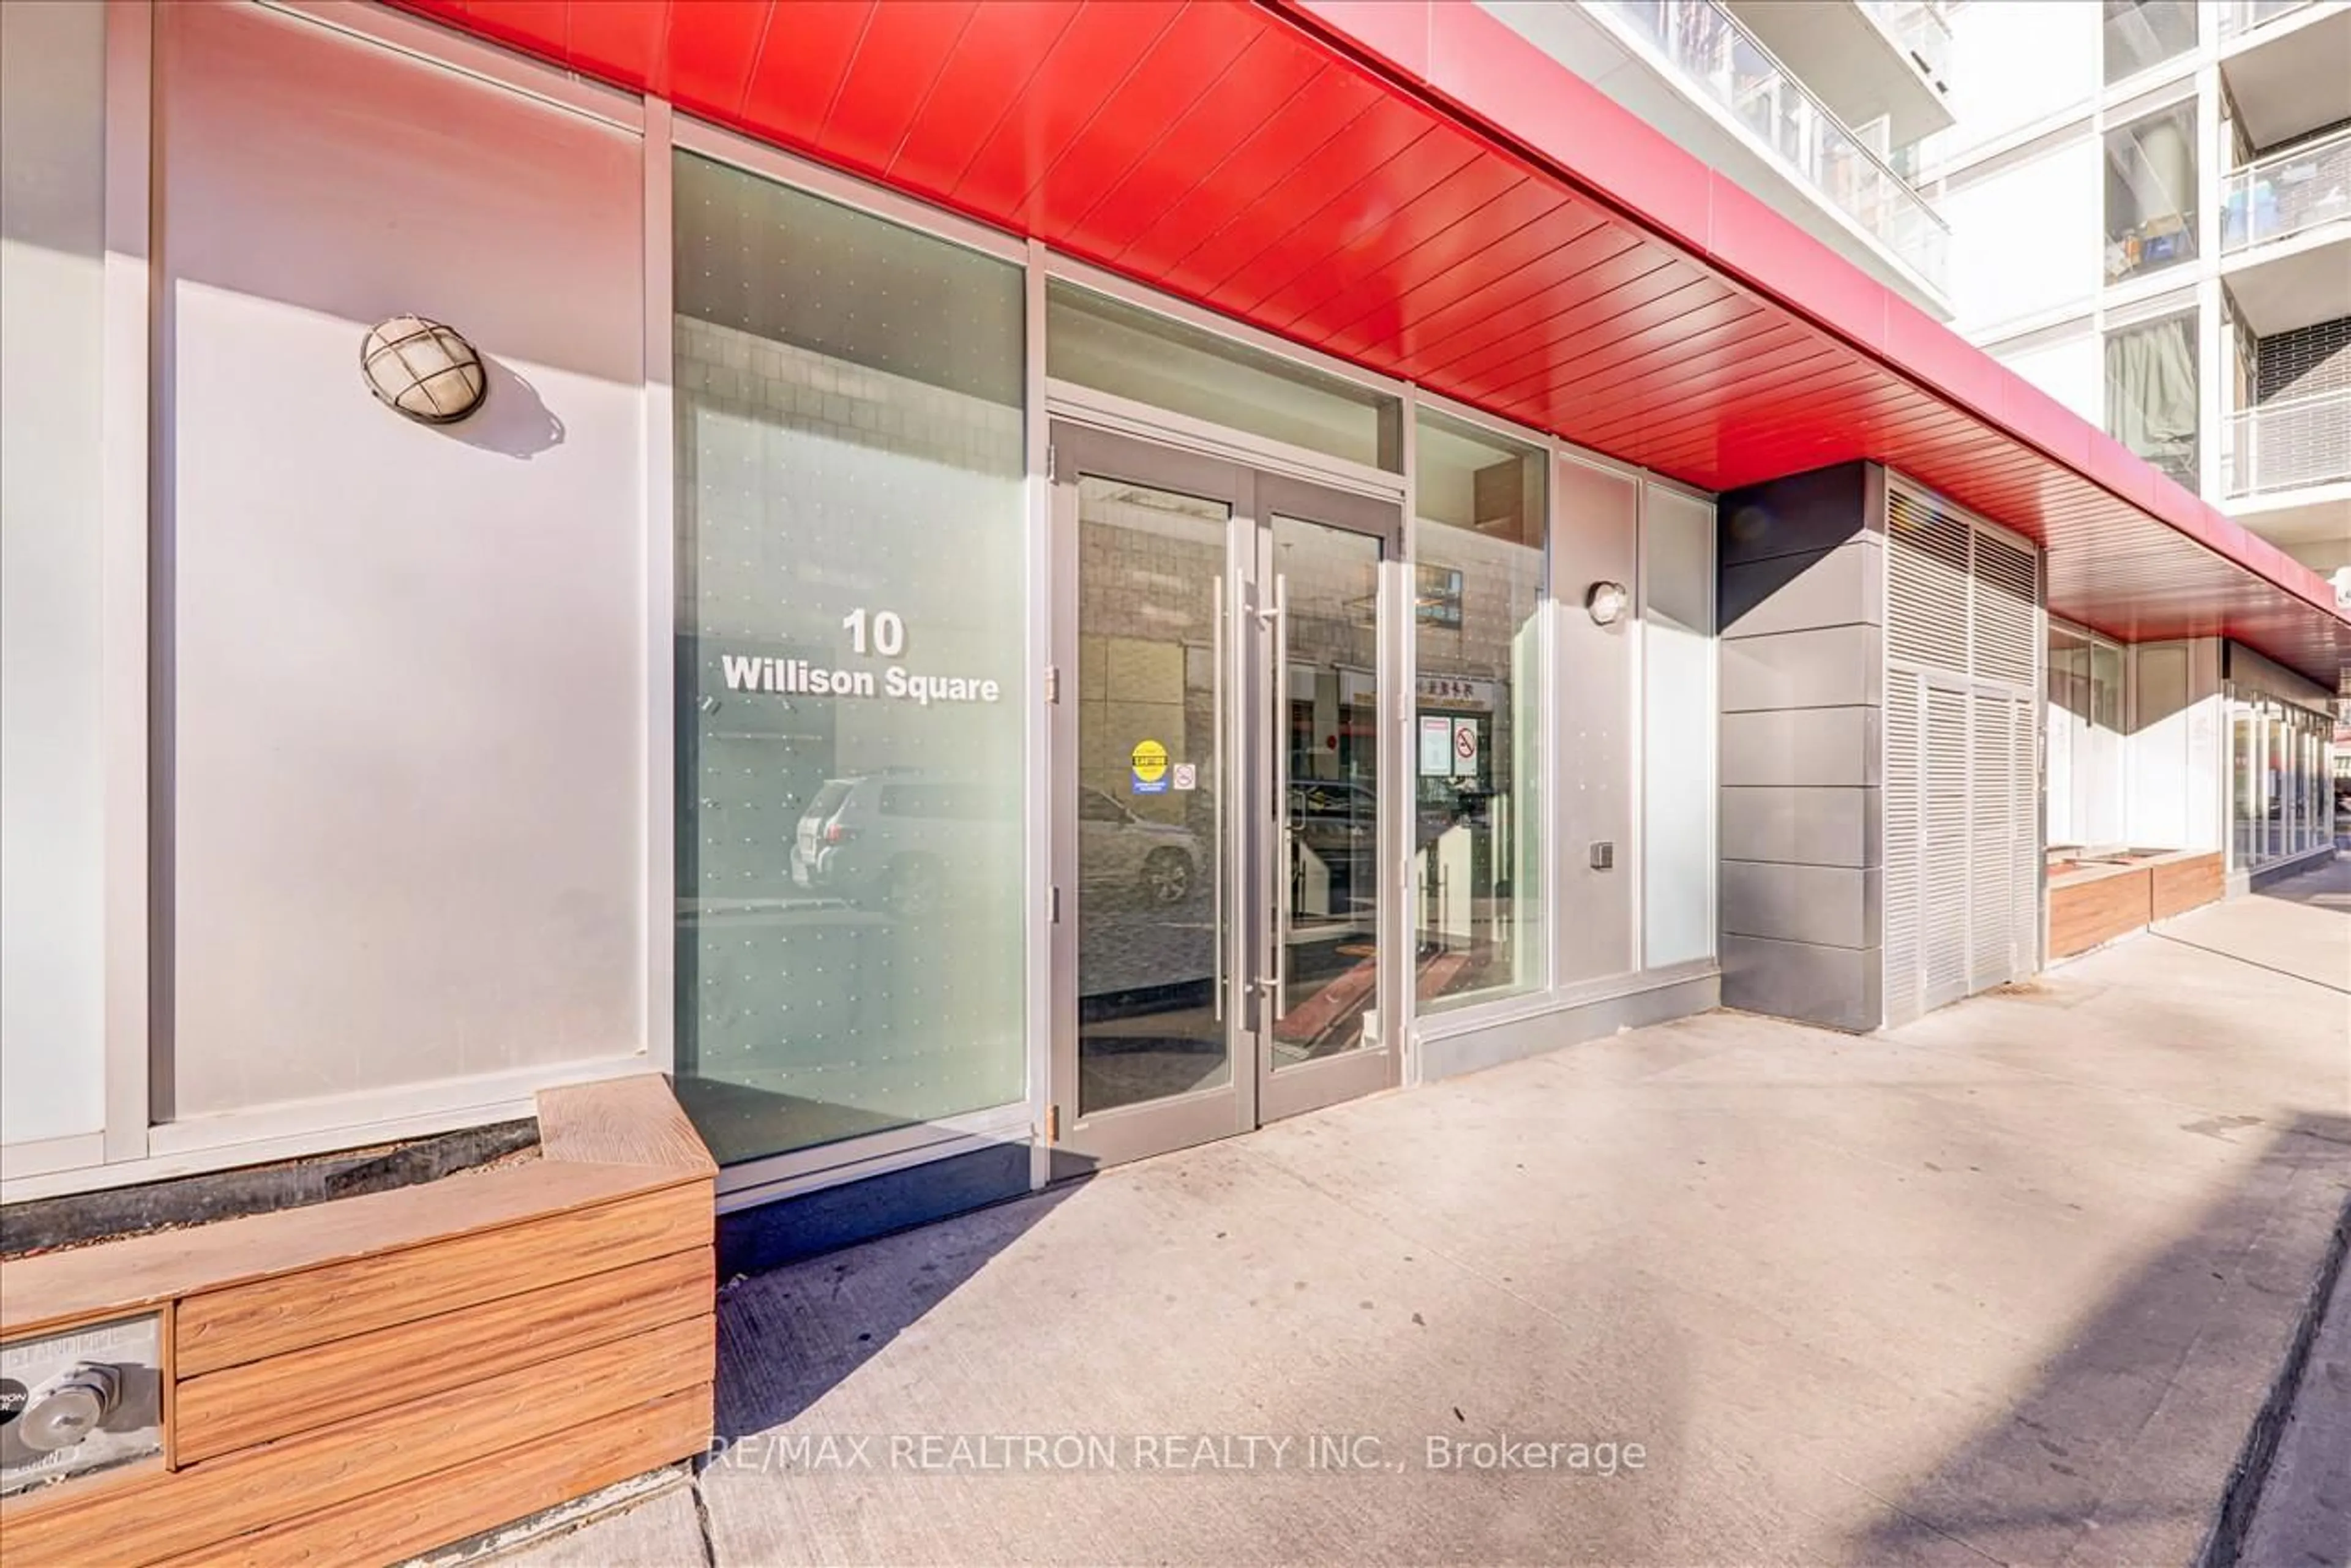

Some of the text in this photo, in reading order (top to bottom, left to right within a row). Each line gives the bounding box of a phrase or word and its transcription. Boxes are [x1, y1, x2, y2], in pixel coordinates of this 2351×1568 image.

[842, 608, 904, 656] 10
[722, 655, 999, 705] Willison Square
